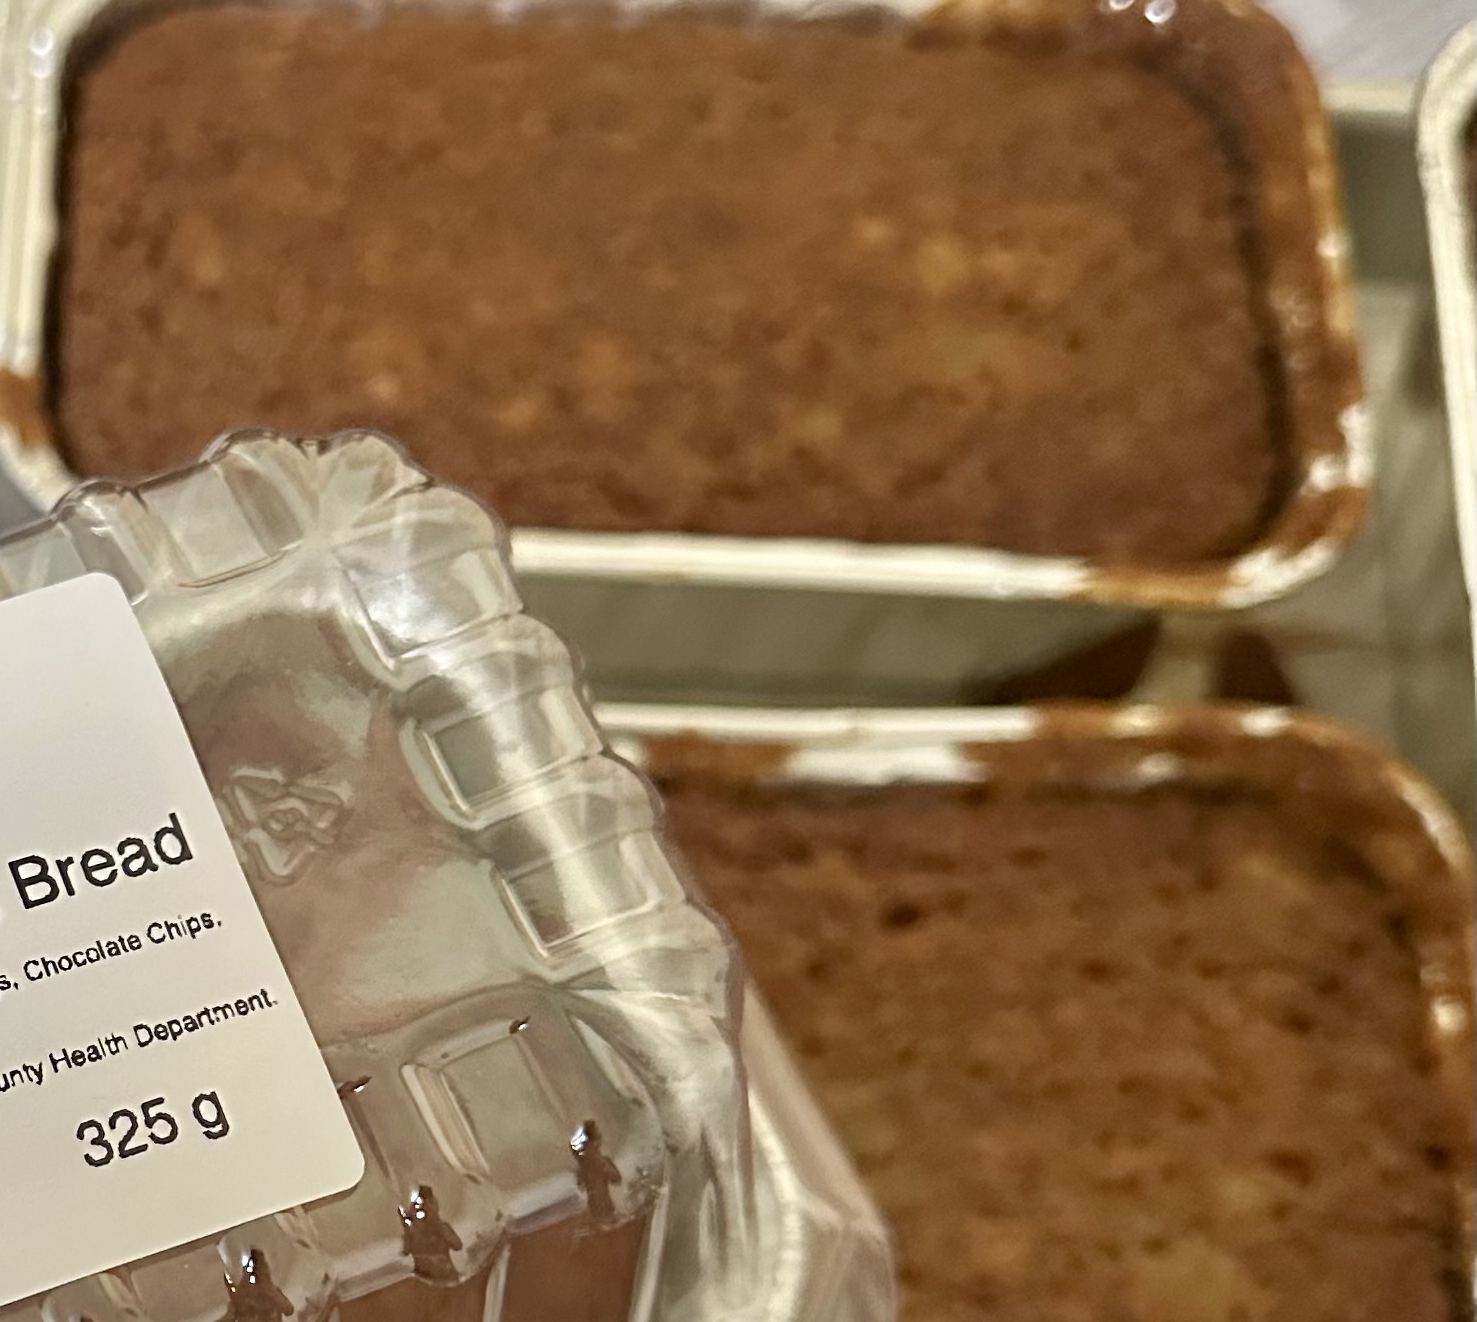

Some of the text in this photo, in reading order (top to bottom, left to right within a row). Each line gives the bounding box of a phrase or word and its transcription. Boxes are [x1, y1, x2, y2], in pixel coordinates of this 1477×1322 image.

[8, 812, 194, 910] Bread
[23, 931, 142, 981] Chocolate
[48, 1032, 129, 1074] Health
[132, 988, 279, 1049] Department.
[76, 1090, 231, 1168] 325 g
